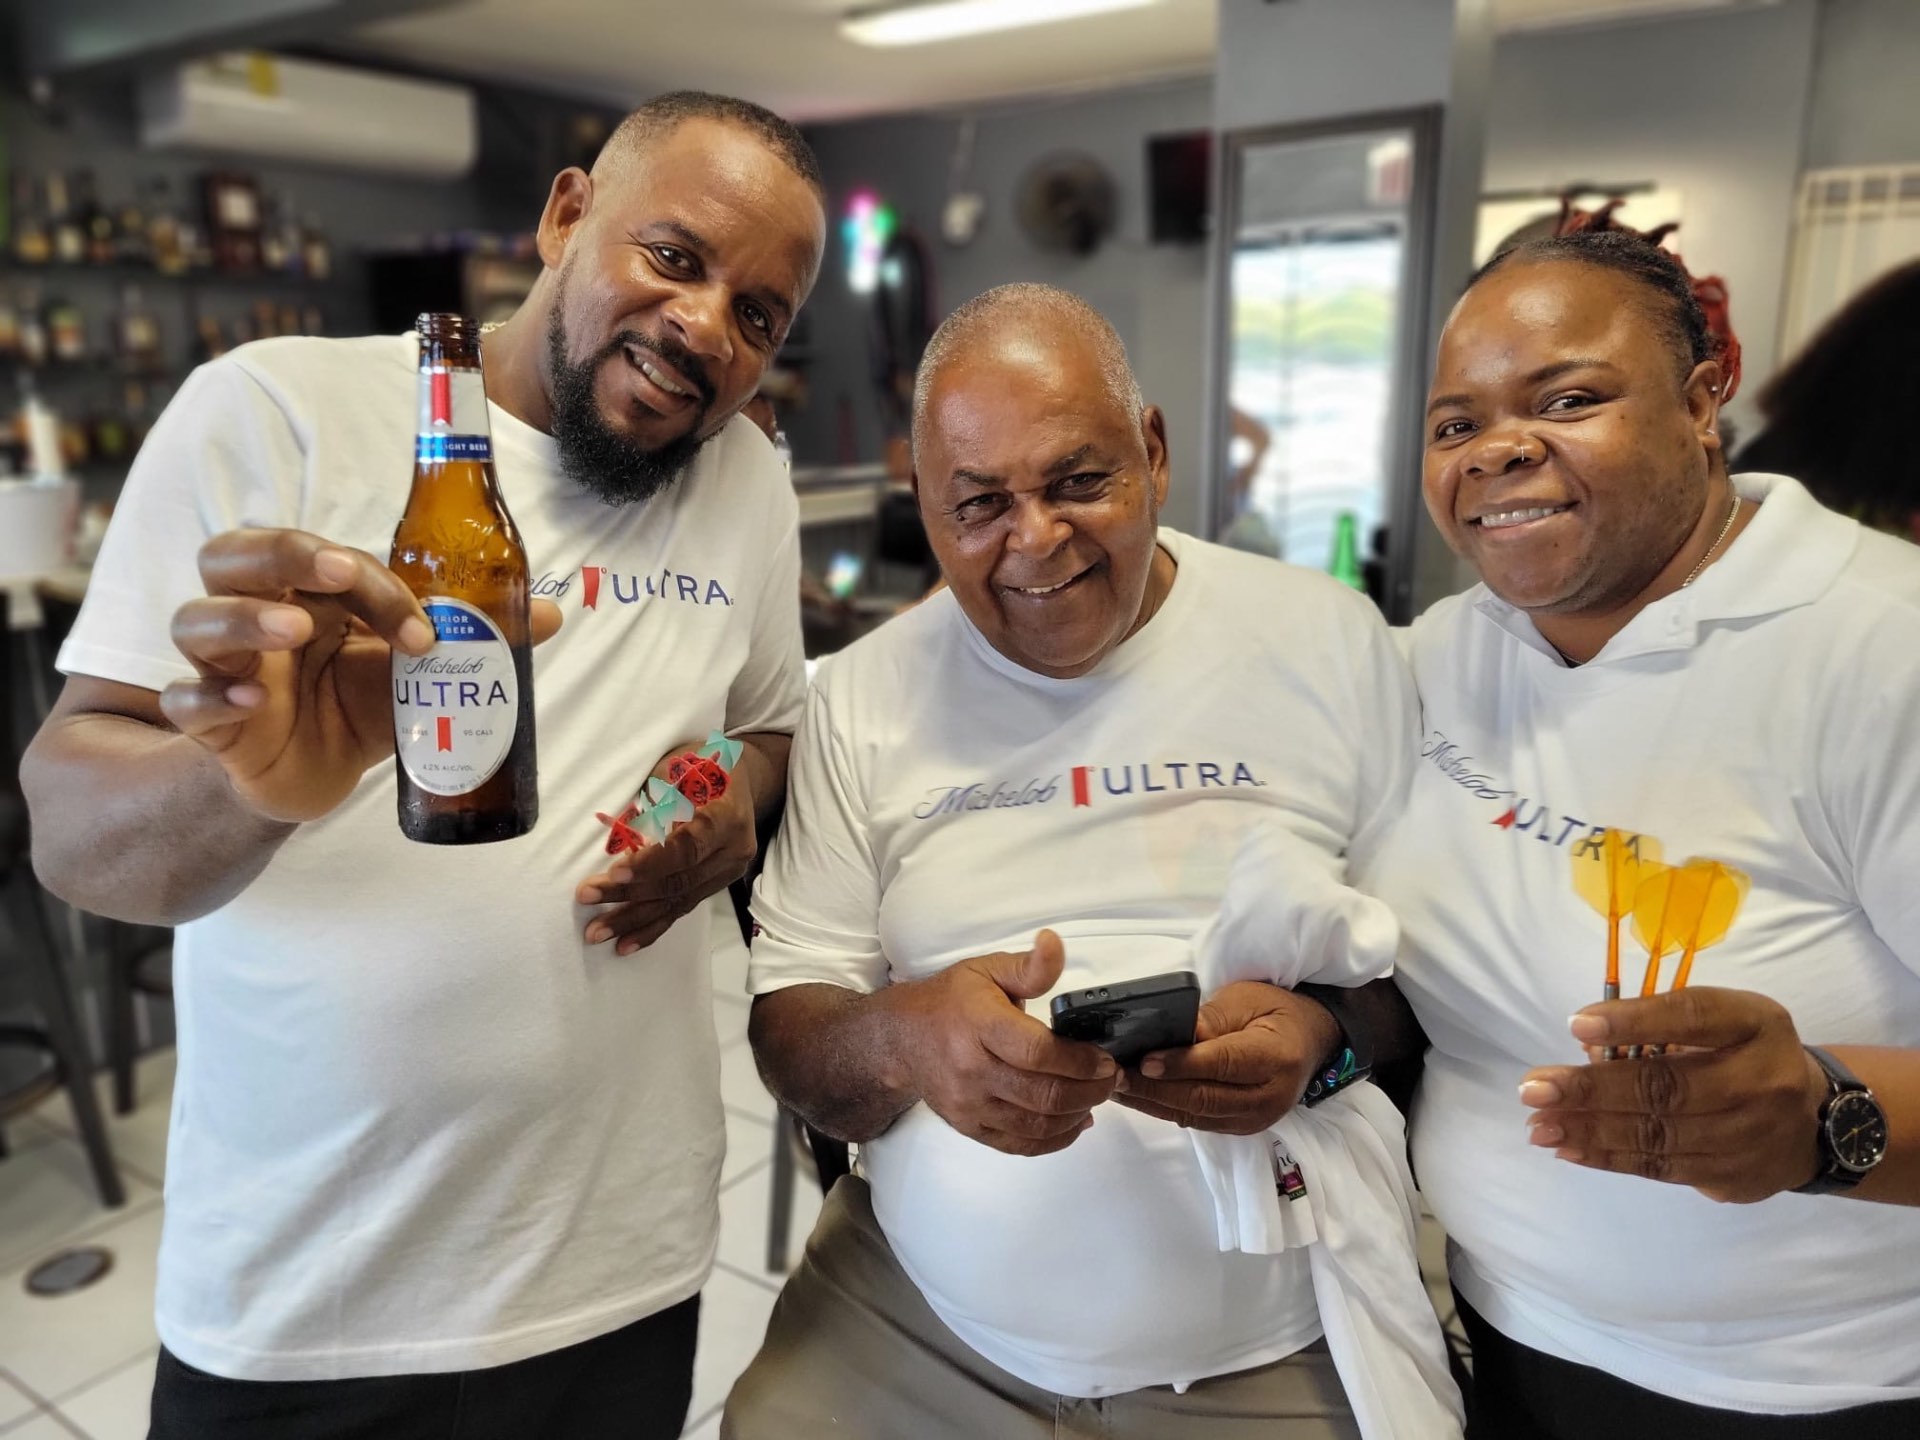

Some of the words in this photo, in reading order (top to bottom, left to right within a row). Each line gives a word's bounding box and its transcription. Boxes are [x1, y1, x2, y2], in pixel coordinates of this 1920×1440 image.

[445, 626, 475, 635] BEER
[403, 656, 486, 675] Michelob
[395, 678, 509, 707] ULTRA
[1420, 730, 1517, 799] Michelob
[913, 774, 1062, 819] Michelob
[1102, 762, 1260, 796] ULTRA
